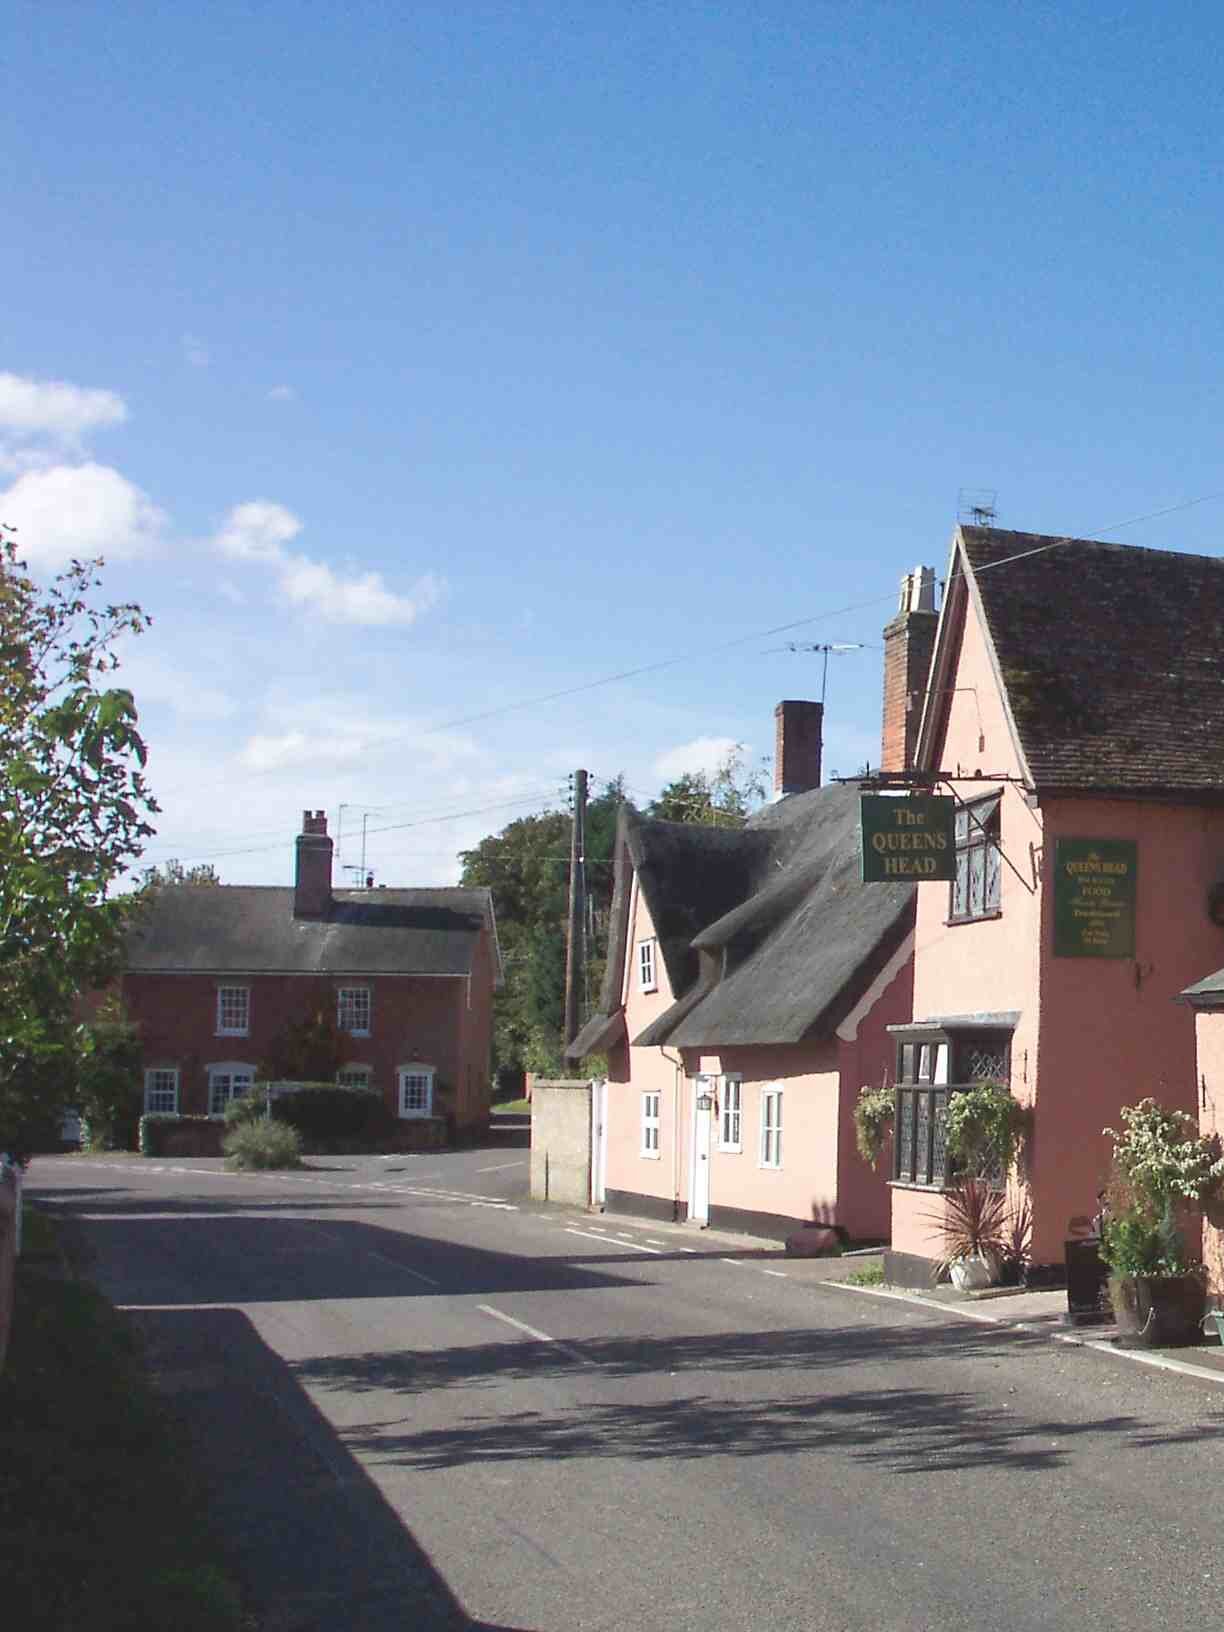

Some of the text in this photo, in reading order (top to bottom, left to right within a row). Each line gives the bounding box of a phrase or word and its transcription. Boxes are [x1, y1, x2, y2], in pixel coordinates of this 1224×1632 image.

[892, 809, 928, 825] The
[872, 832, 946, 853] QUEENS
[884, 856, 937, 874] HEAD
[1082, 887, 1112, 897] FOOD
